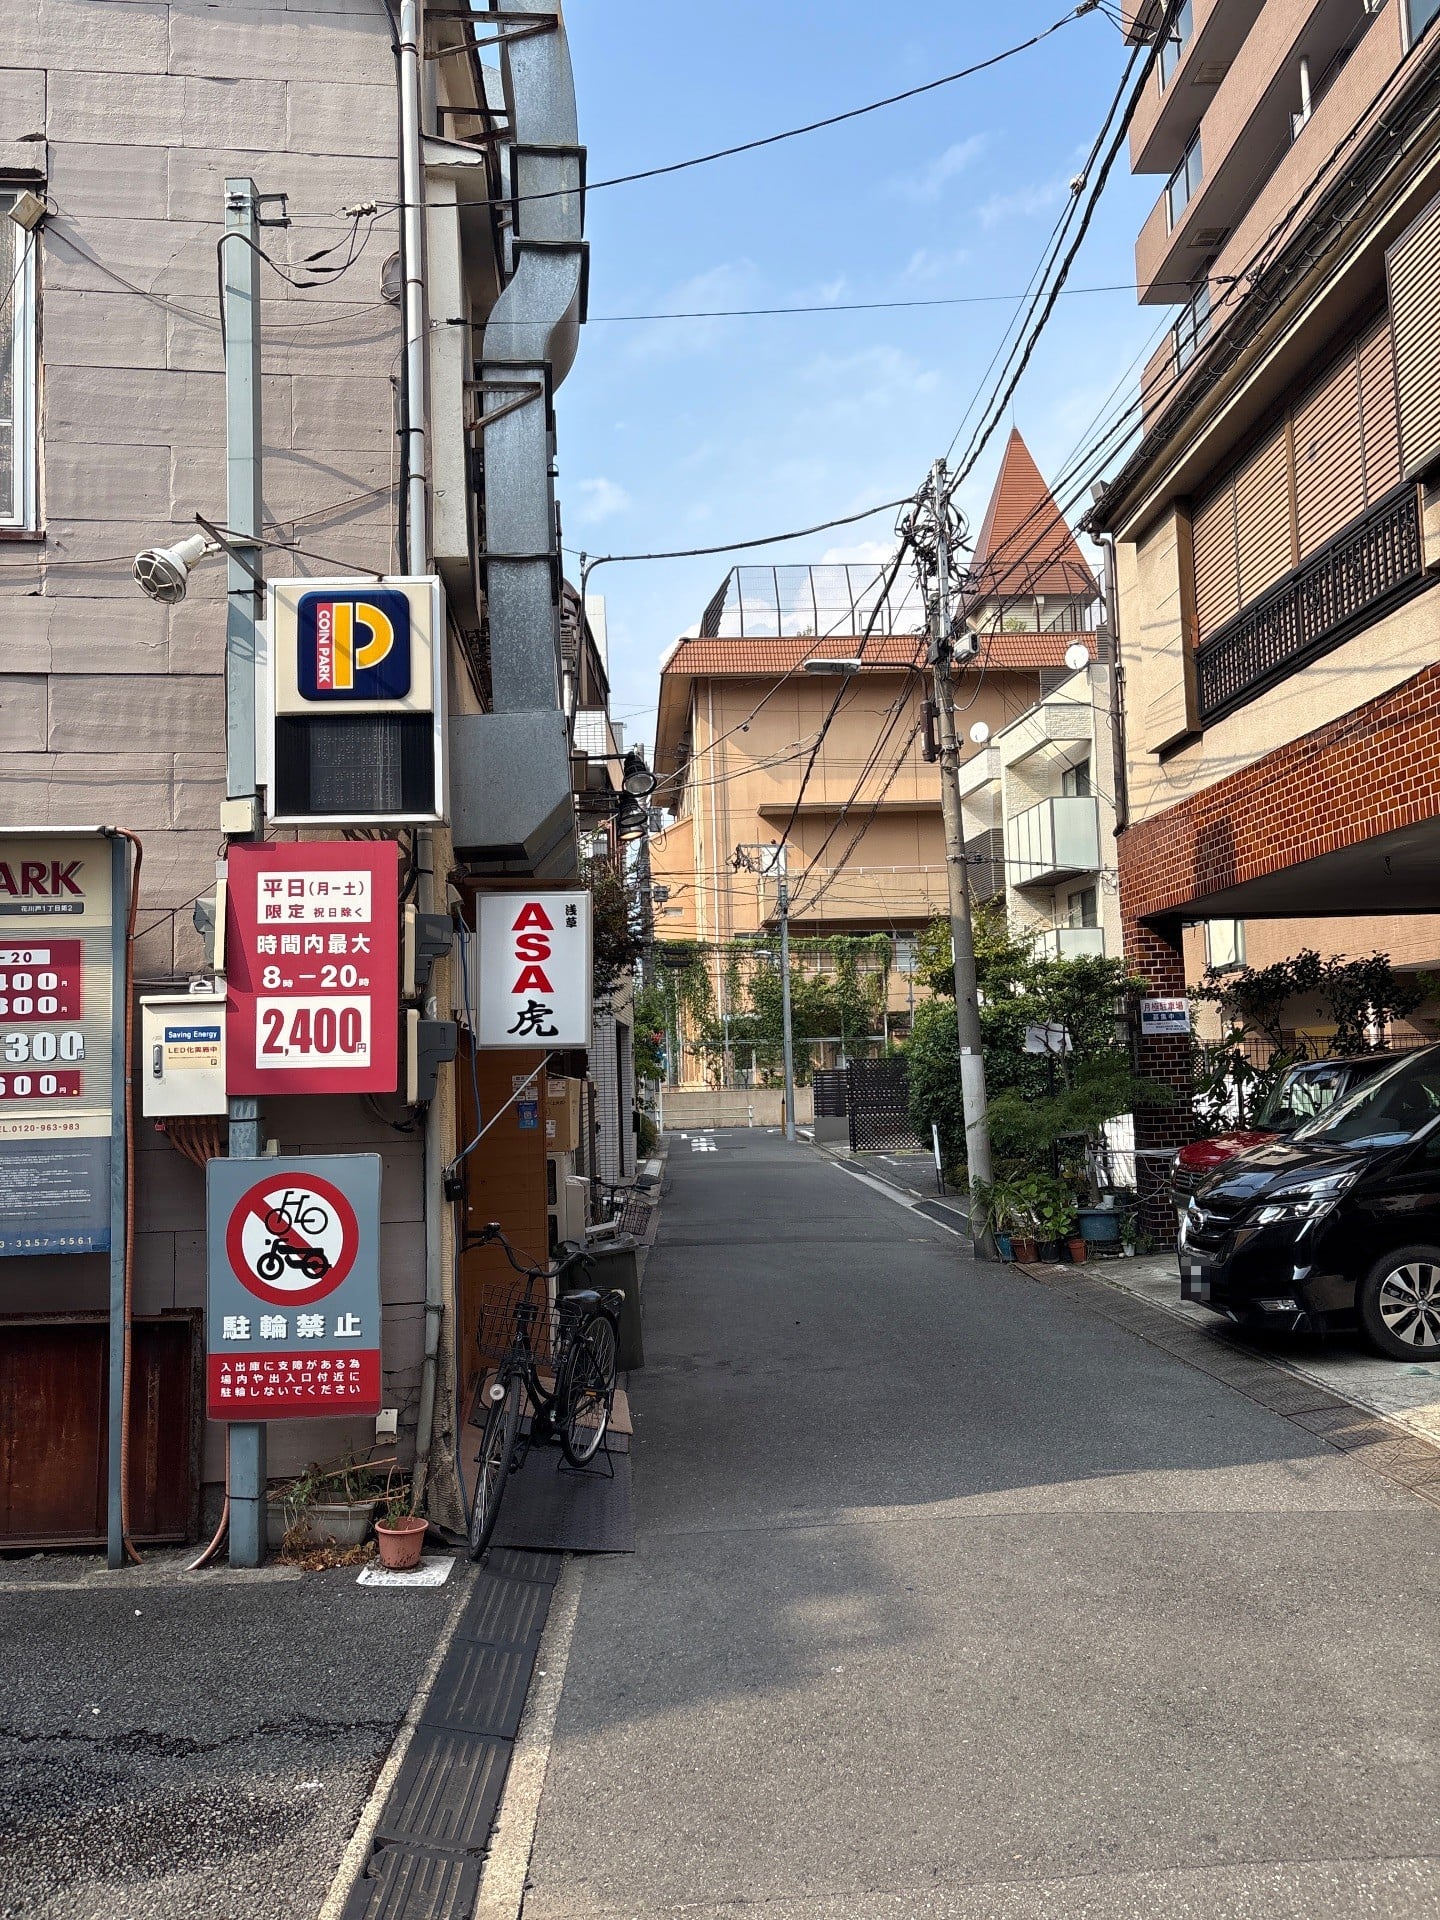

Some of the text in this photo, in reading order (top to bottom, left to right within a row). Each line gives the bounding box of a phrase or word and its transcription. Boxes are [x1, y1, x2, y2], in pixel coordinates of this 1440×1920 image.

[318, 610, 330, 683] COIN PARK
[265, 904, 363, 919] 限定 祝日除く
[565, 904, 577, 928] 浅草
[256, 933, 371, 955] 時間内最大
[168, 1030, 218, 1040] Saving Energy
[222, 1312, 362, 1340] 駐輪禁止
[220, 1358, 361, 1373] 入出庫に支障がある為
[220, 1372, 360, 1385] 場内や出入口付近に
[220, 1384, 361, 1398] 駐輪しないでください
